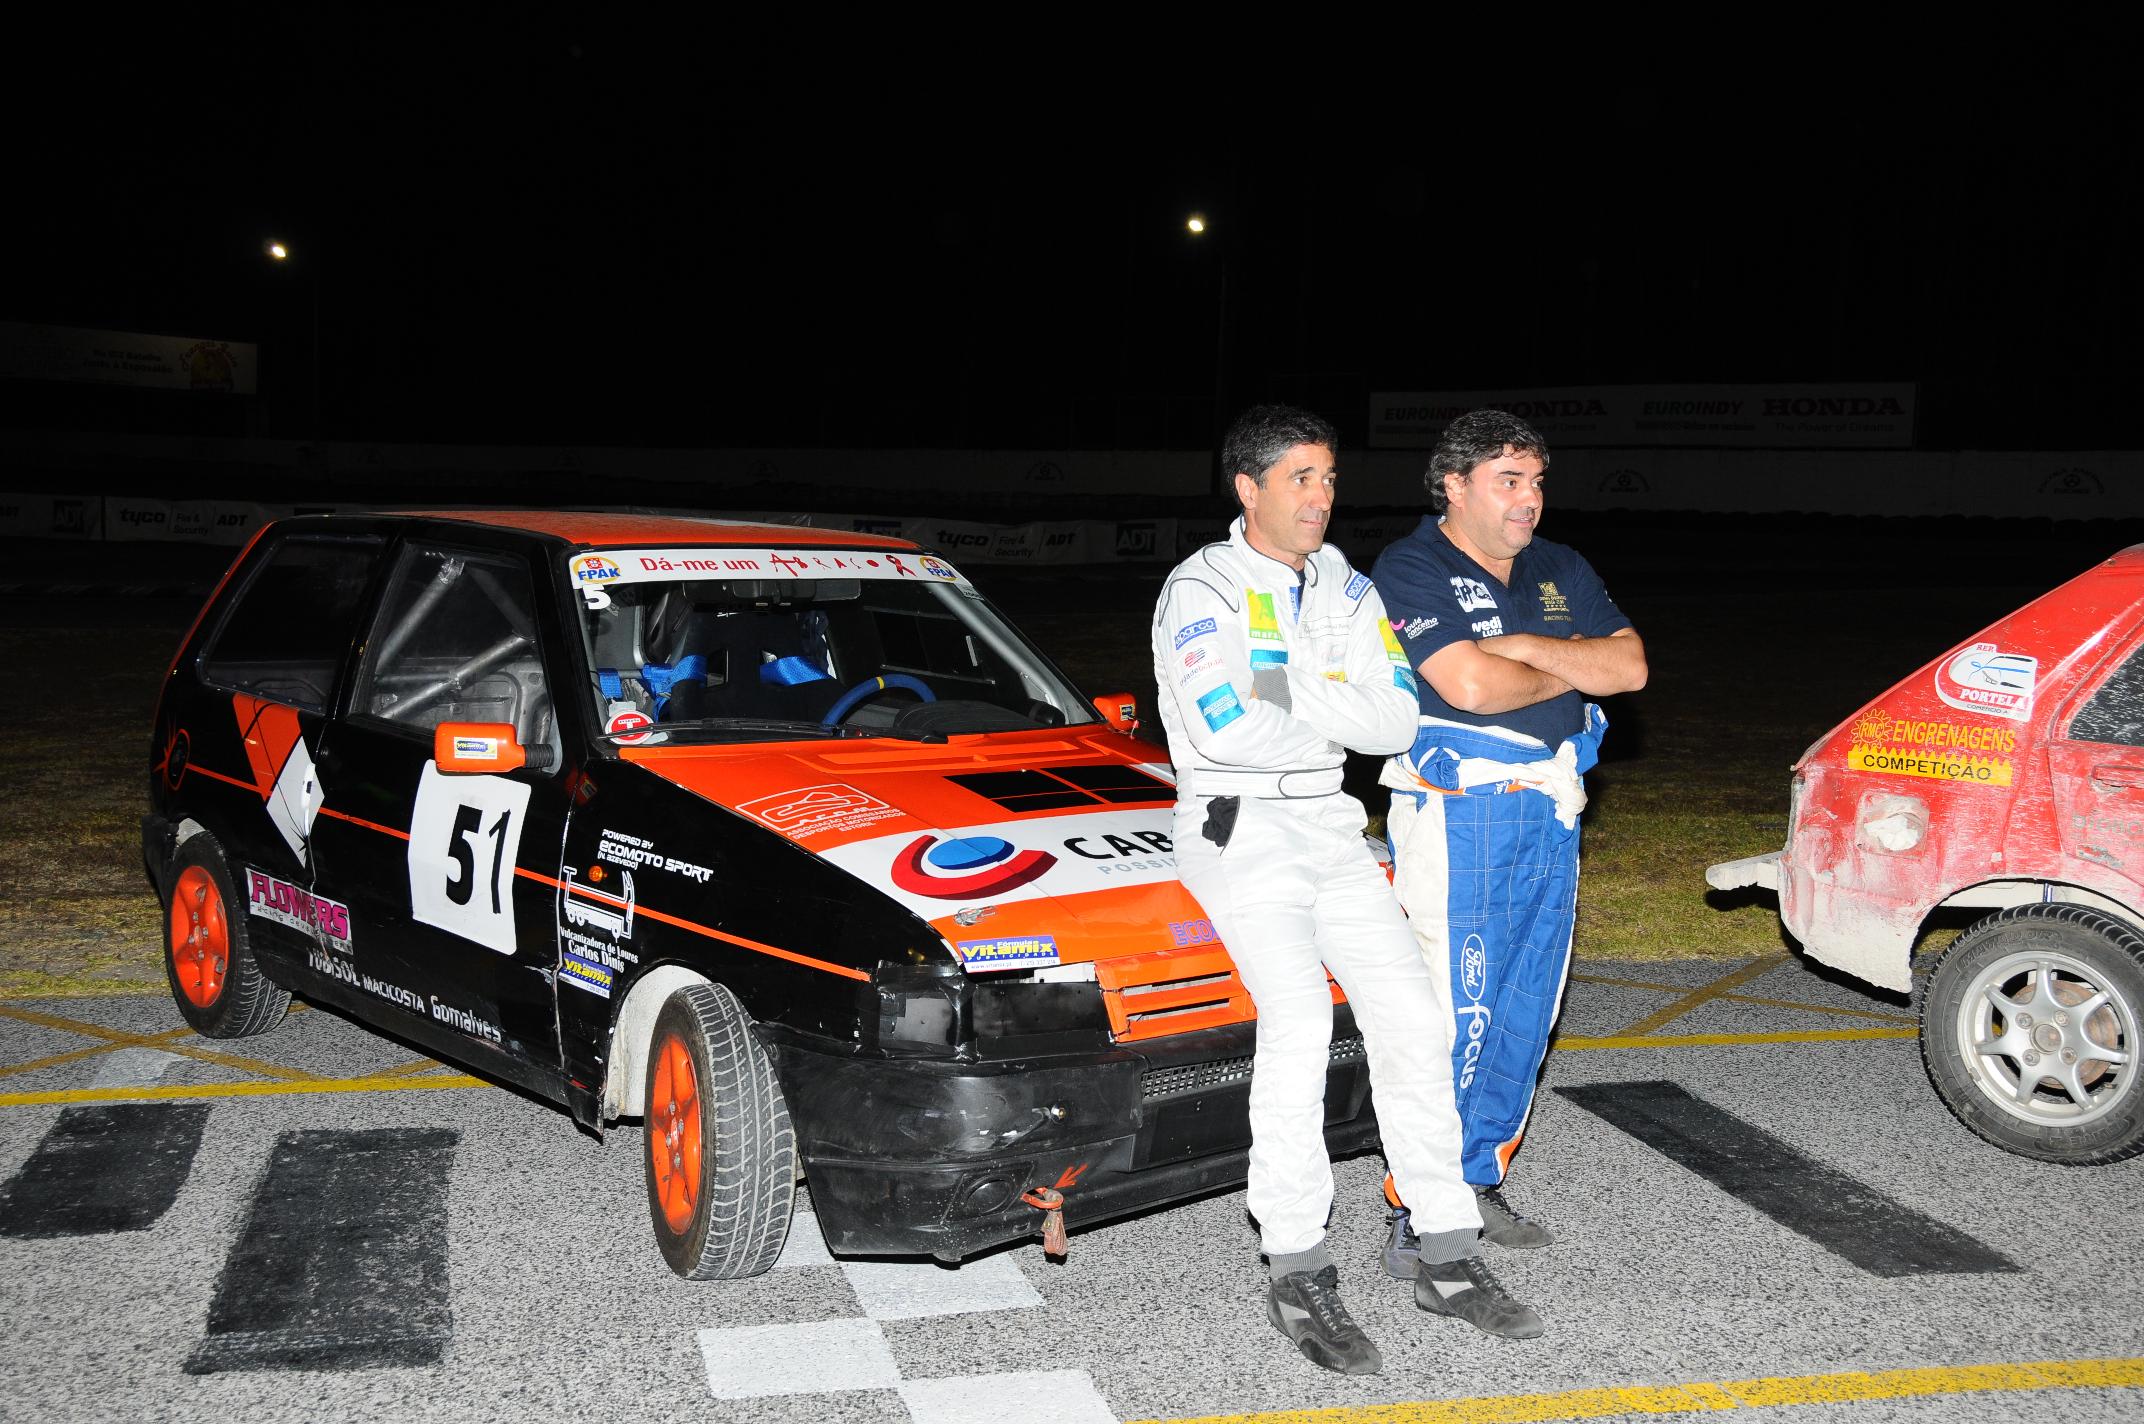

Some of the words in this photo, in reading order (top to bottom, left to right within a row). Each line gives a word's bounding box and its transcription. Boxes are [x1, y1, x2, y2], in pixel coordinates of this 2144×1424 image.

[1643, 400, 1745, 416] EUROINDY
[1761, 398, 1906, 416] HONDA
[120, 508, 165, 526] tyco
[217, 514, 248, 526] ADT
[936, 529, 989, 548] tyco
[1046, 532, 1077, 546] ADT
[1118, 528, 1155, 551] ADT
[577, 567, 621, 582] FPAK
[640, 556, 718, 571] Dá-me
[723, 560, 760, 570] um
[927, 567, 957, 579] FPAK
[583, 584, 612, 610] 5
[1175, 619, 1215, 645] sparco
[1407, 617, 1438, 638] concelho
[1482, 628, 1503, 638] LUSA
[1960, 688, 2029, 710] PORTELA
[1858, 721, 1884, 738] RMC
[1892, 719, 2017, 753] ENGRENAGENS
[601, 828, 641, 847] POWERED
[446, 803, 511, 915] 51
[664, 858, 714, 883] SPORT
[250, 871, 348, 940] FLOWERS
[568, 939, 600, 963] Carlos
[601, 951, 625, 974] Dinis
[960, 942, 1054, 958] Vitamix
[564, 958, 612, 985] Vitamix
[1465, 948, 1482, 988] Ford
[1458, 1002, 1491, 1090] focus
